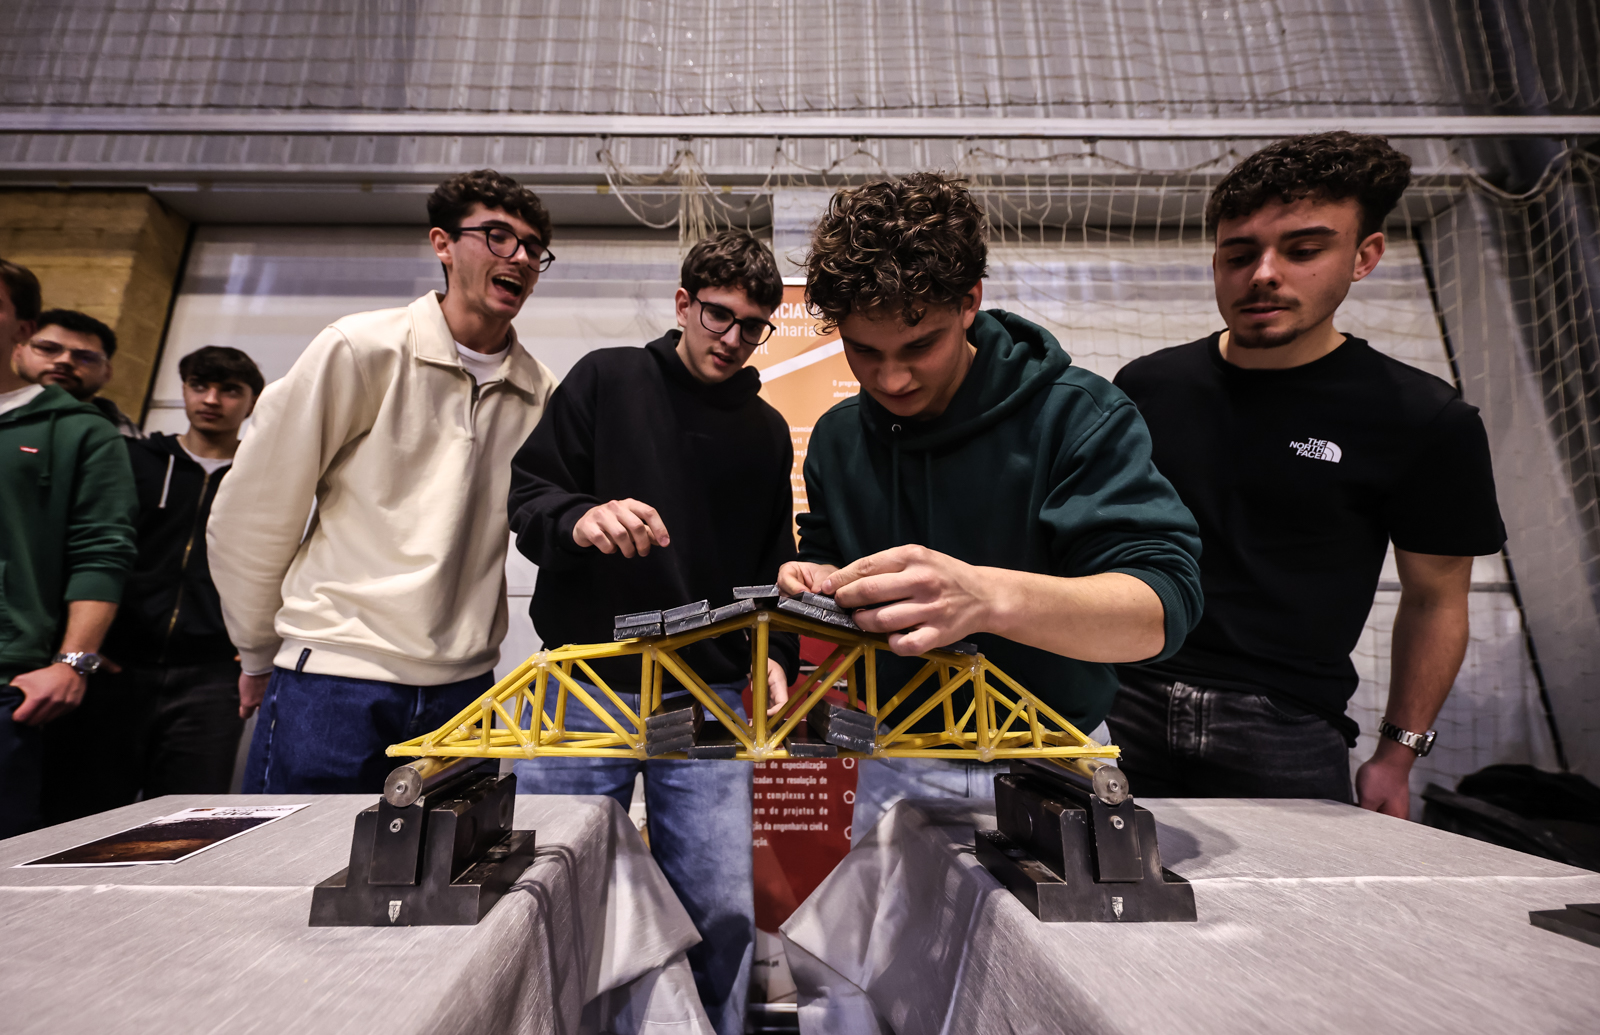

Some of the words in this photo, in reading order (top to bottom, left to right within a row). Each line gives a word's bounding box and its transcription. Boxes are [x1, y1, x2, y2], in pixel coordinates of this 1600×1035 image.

[771, 322, 816, 337] nharia
[1289, 440, 1325, 453] NORTH
[1308, 437, 1327, 447] THE
[1296, 448, 1321, 459] FACE
[770, 761, 778, 769] de
[782, 760, 827, 771] especialização
[787, 775, 817, 786] resolução
[819, 775, 827, 784] de
[767, 790, 805, 801] complexos
[769, 806, 779, 815] de
[783, 806, 815, 817] projetos
[819, 806, 828, 815] de
[763, 822, 771, 830] da
[773, 822, 808, 832] engenharia
[809, 822, 823, 831] civil
